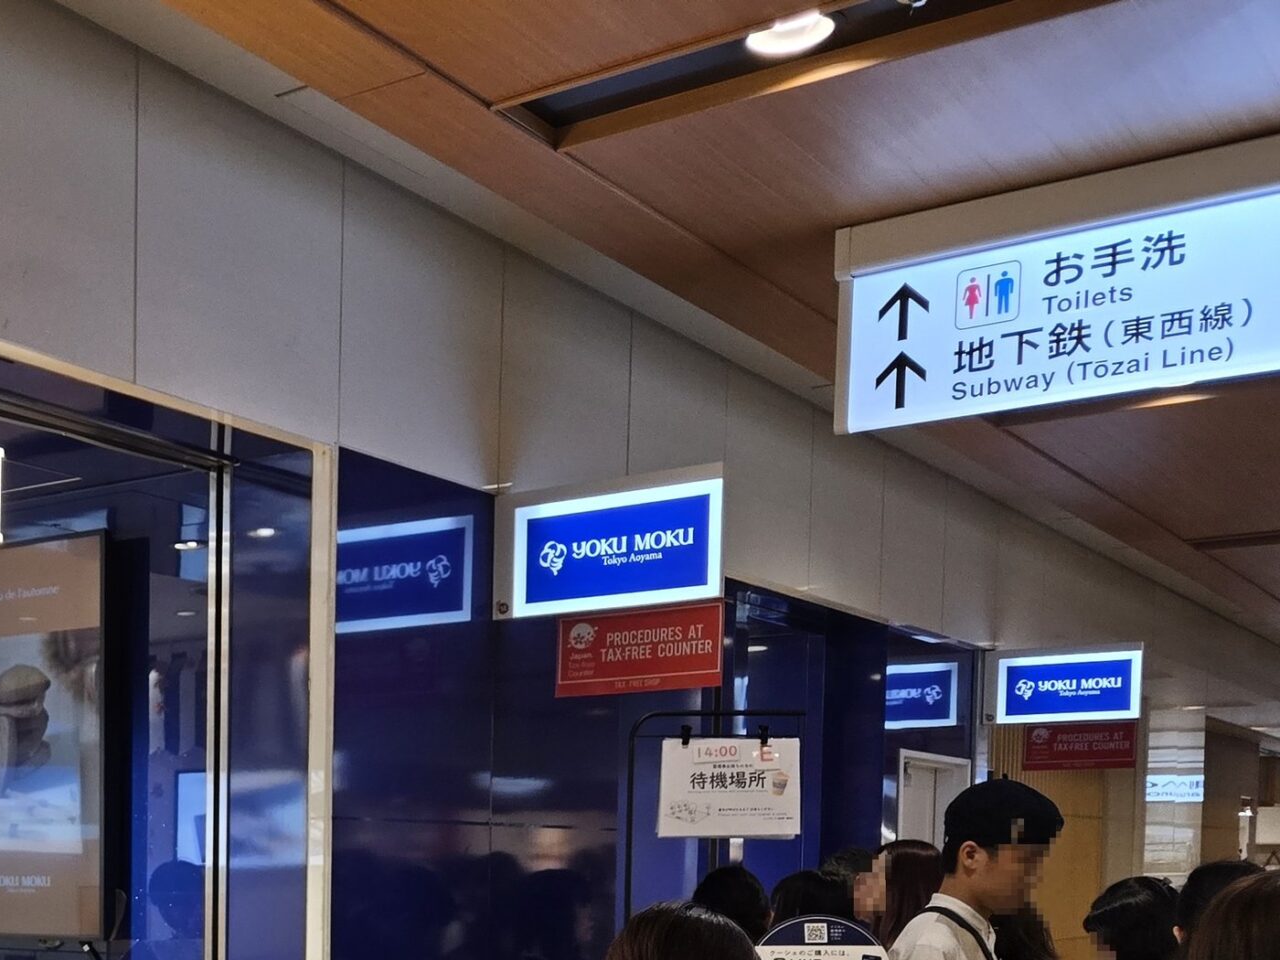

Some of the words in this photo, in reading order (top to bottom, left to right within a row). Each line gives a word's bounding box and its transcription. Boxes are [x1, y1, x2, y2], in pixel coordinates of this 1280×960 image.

[1042, 230, 1186, 288] お手洗
[1042, 283, 1133, 316] Toilets
[951, 367, 1056, 401] Subway
[1067, 355, 1151, 386] (Tōzai
[1162, 337, 1235, 370] Line)
[572, 536, 627, 559] YOKU
[634, 527, 694, 551] MOKU
[602, 555, 627, 567] Tokyo
[629, 551, 662, 563] Aoyama
[606, 626, 682, 647] PROCEDURES
[688, 624, 704, 640] AT
[600, 645, 652, 663] TAX-FREE
[658, 639, 713, 658] COUNTER
[1038, 679, 1077, 691] YOKU
[1081, 677, 1122, 689] MOKU
[698, 745, 737, 759] 14:00
[690, 771, 767, 790] 待機場所
